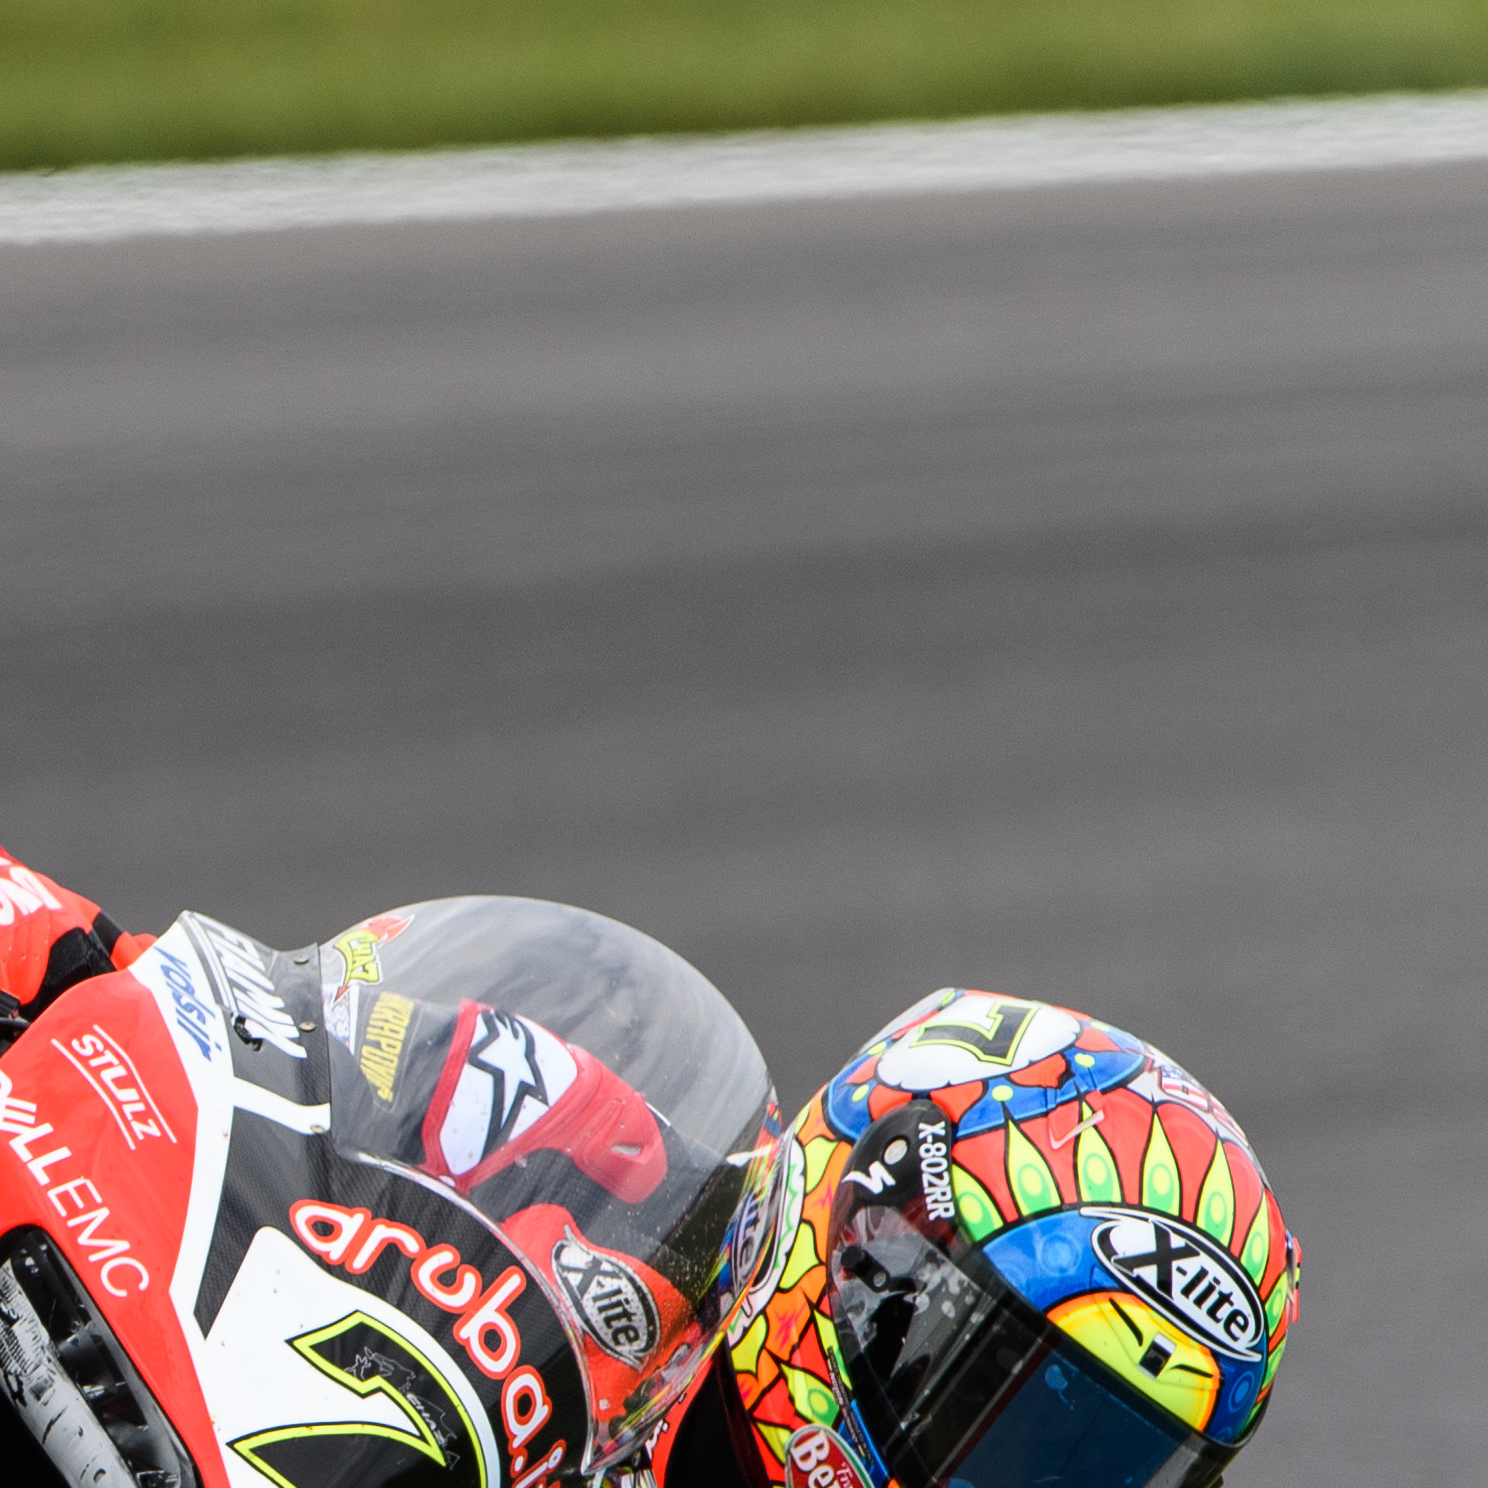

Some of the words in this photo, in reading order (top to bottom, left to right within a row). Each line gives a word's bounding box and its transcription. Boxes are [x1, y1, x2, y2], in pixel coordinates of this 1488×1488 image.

[153, 946, 222, 1062] valsir
[71, 1034, 161, 1140] STULZ
[918, 1120, 956, 1221] X-802RR
[47, 1176, 149, 1297] EMC
[1111, 1218, 1250, 1343] X-lite
[559, 1252, 640, 1347] X-lite
